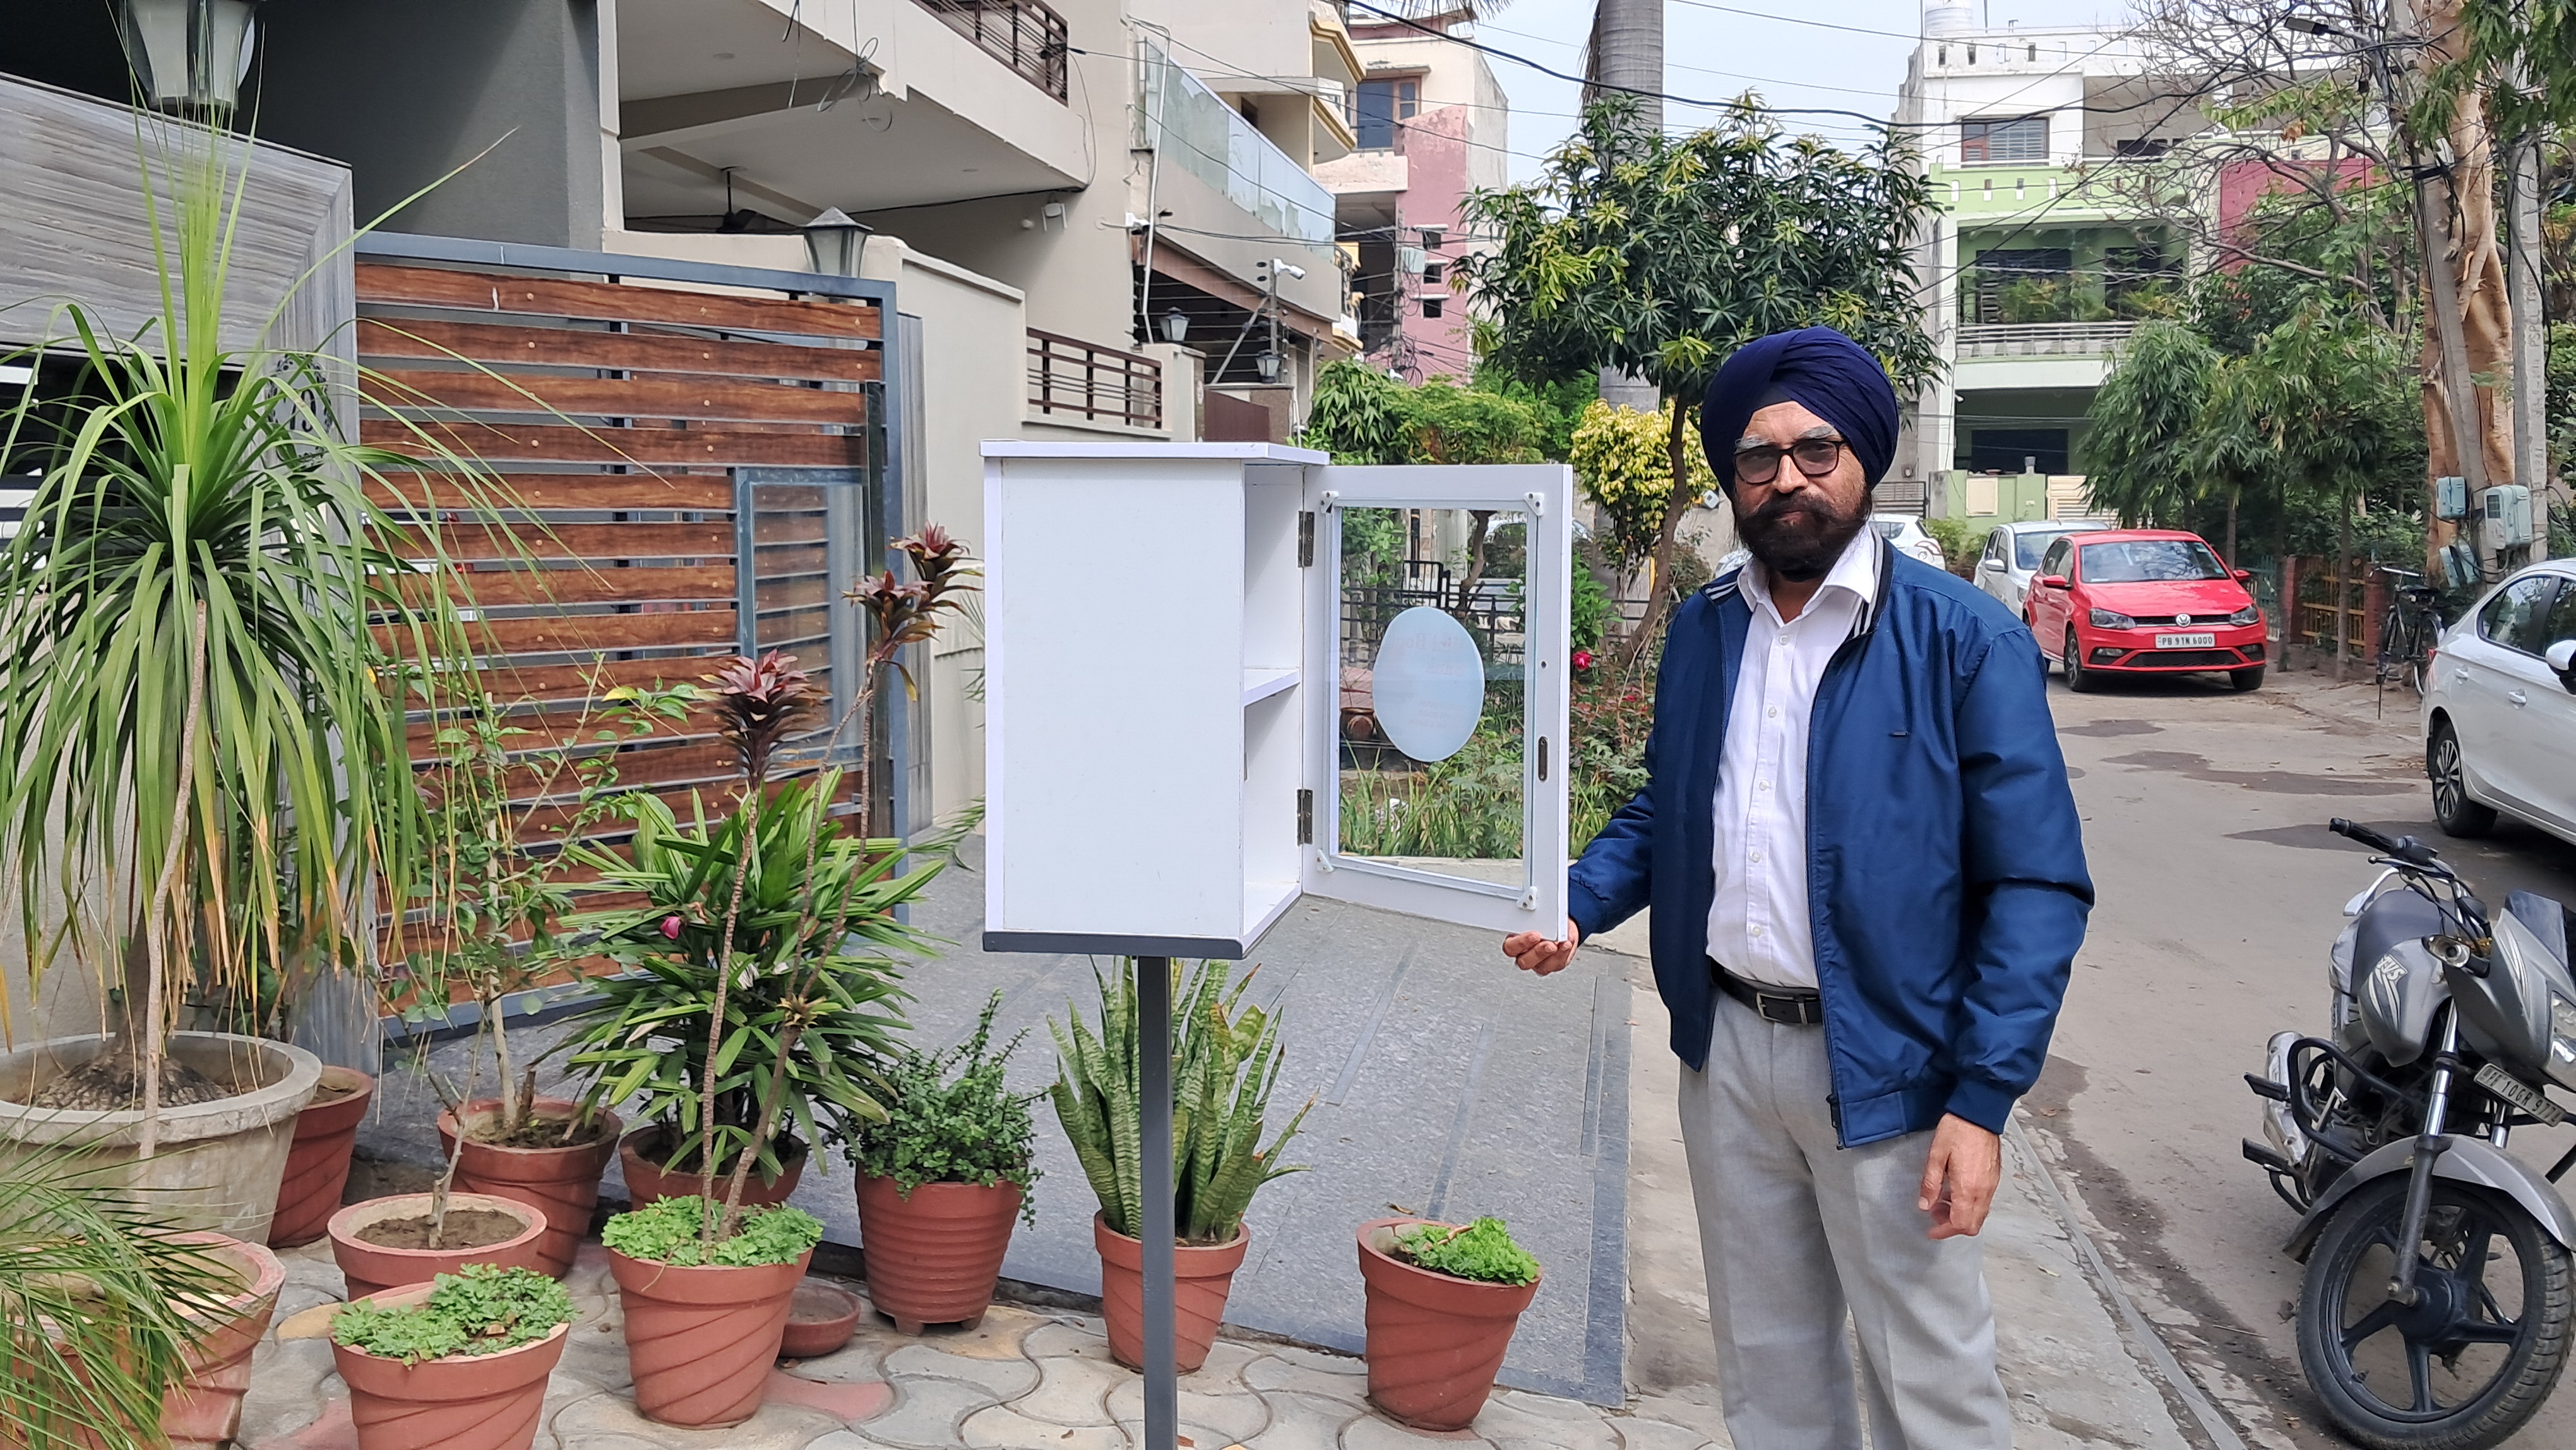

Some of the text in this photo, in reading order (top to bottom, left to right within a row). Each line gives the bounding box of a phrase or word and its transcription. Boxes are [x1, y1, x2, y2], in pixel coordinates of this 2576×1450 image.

[2162, 637, 2173, 646] PB
[2193, 636, 2213, 645] 6000
[2376, 954, 2406, 980] TVS
[2501, 1081, 2533, 1106] 10GR
